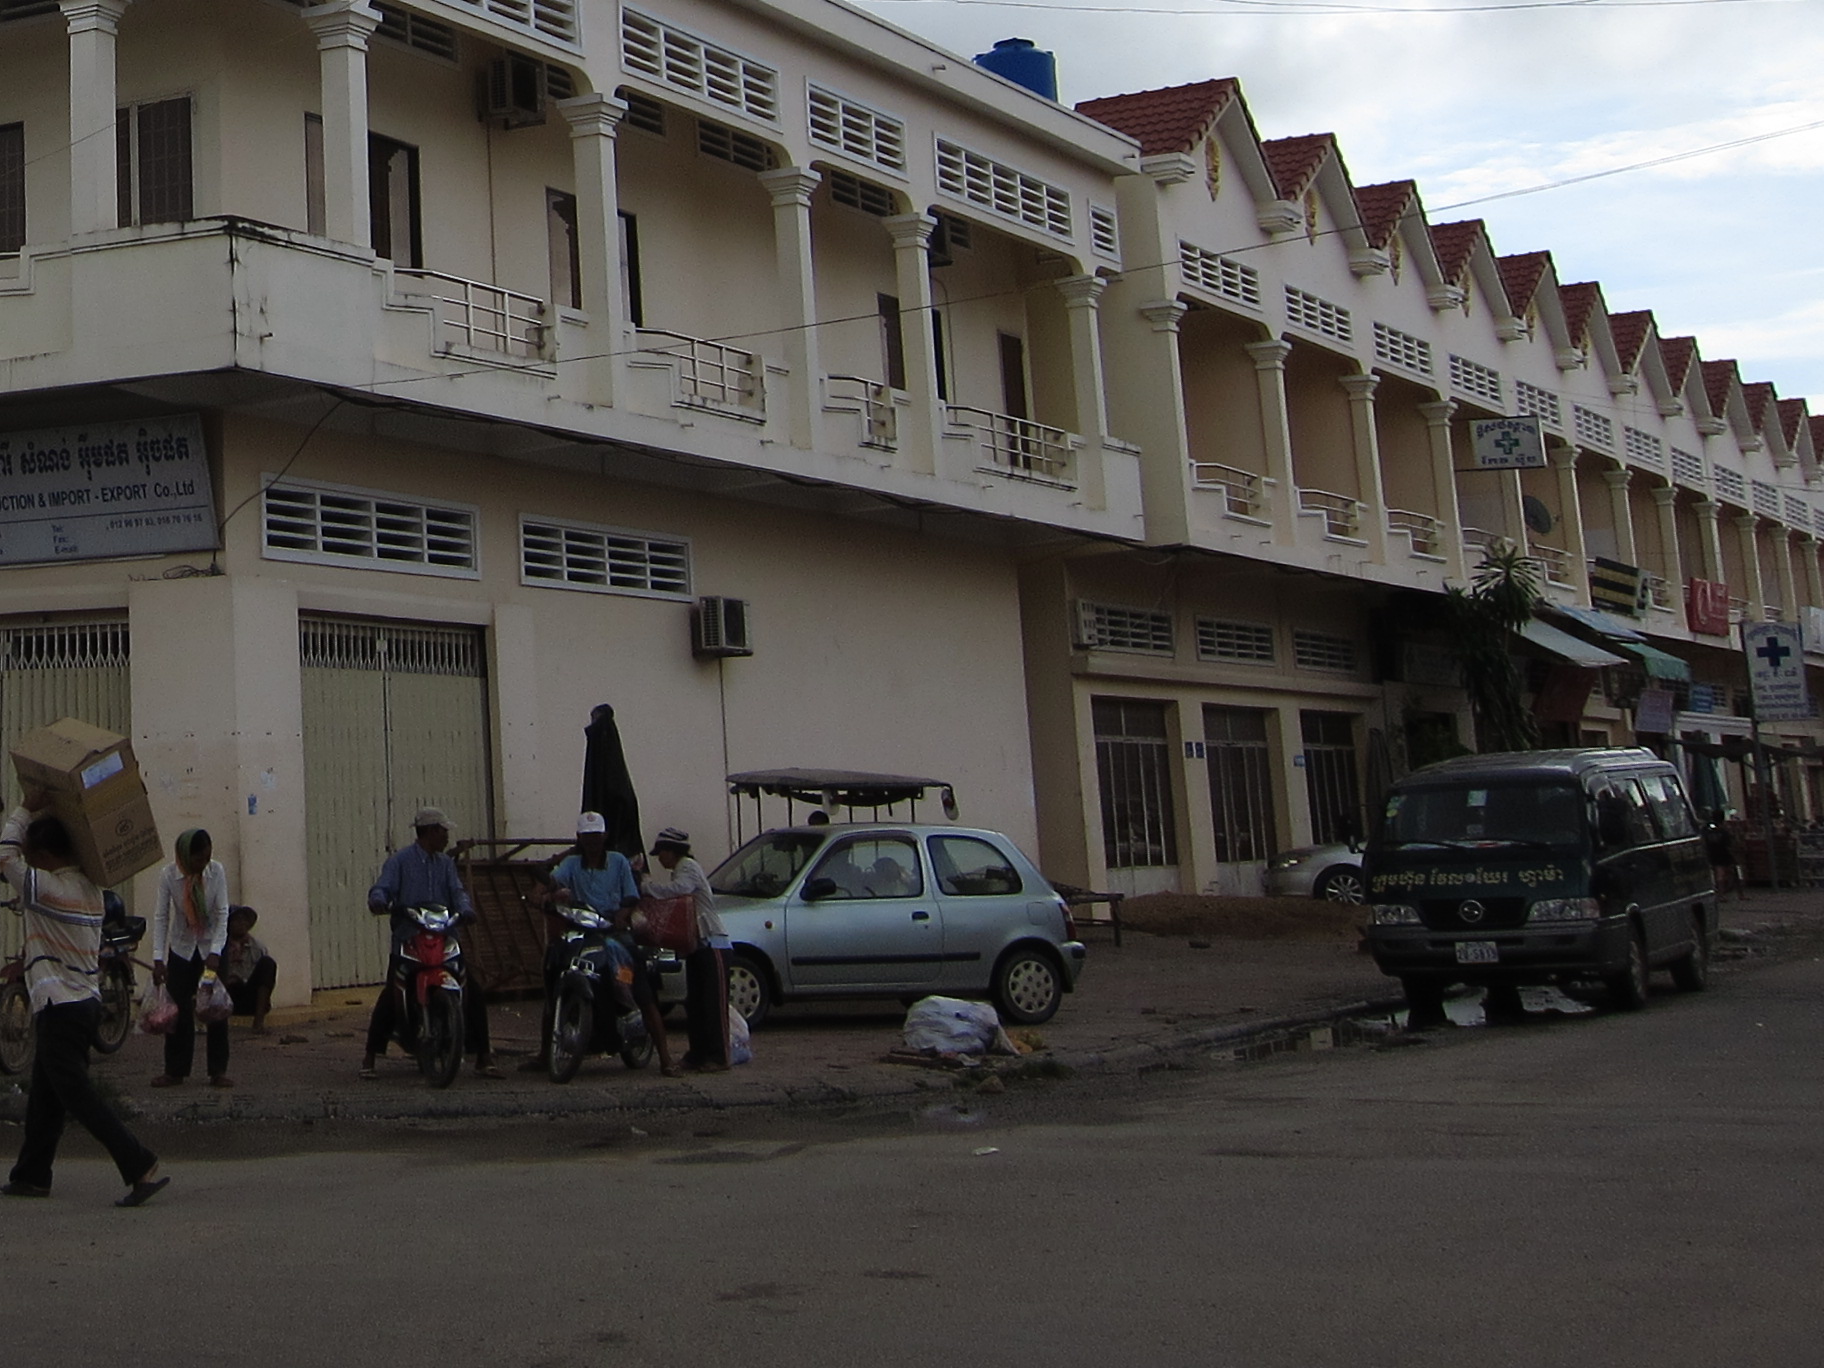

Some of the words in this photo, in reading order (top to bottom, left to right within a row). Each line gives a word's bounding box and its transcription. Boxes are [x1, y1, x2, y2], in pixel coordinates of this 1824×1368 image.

[38, 496, 47, 508] &
[48, 488, 91, 507] IMPORT
[101, 483, 147, 503] EXPORT
